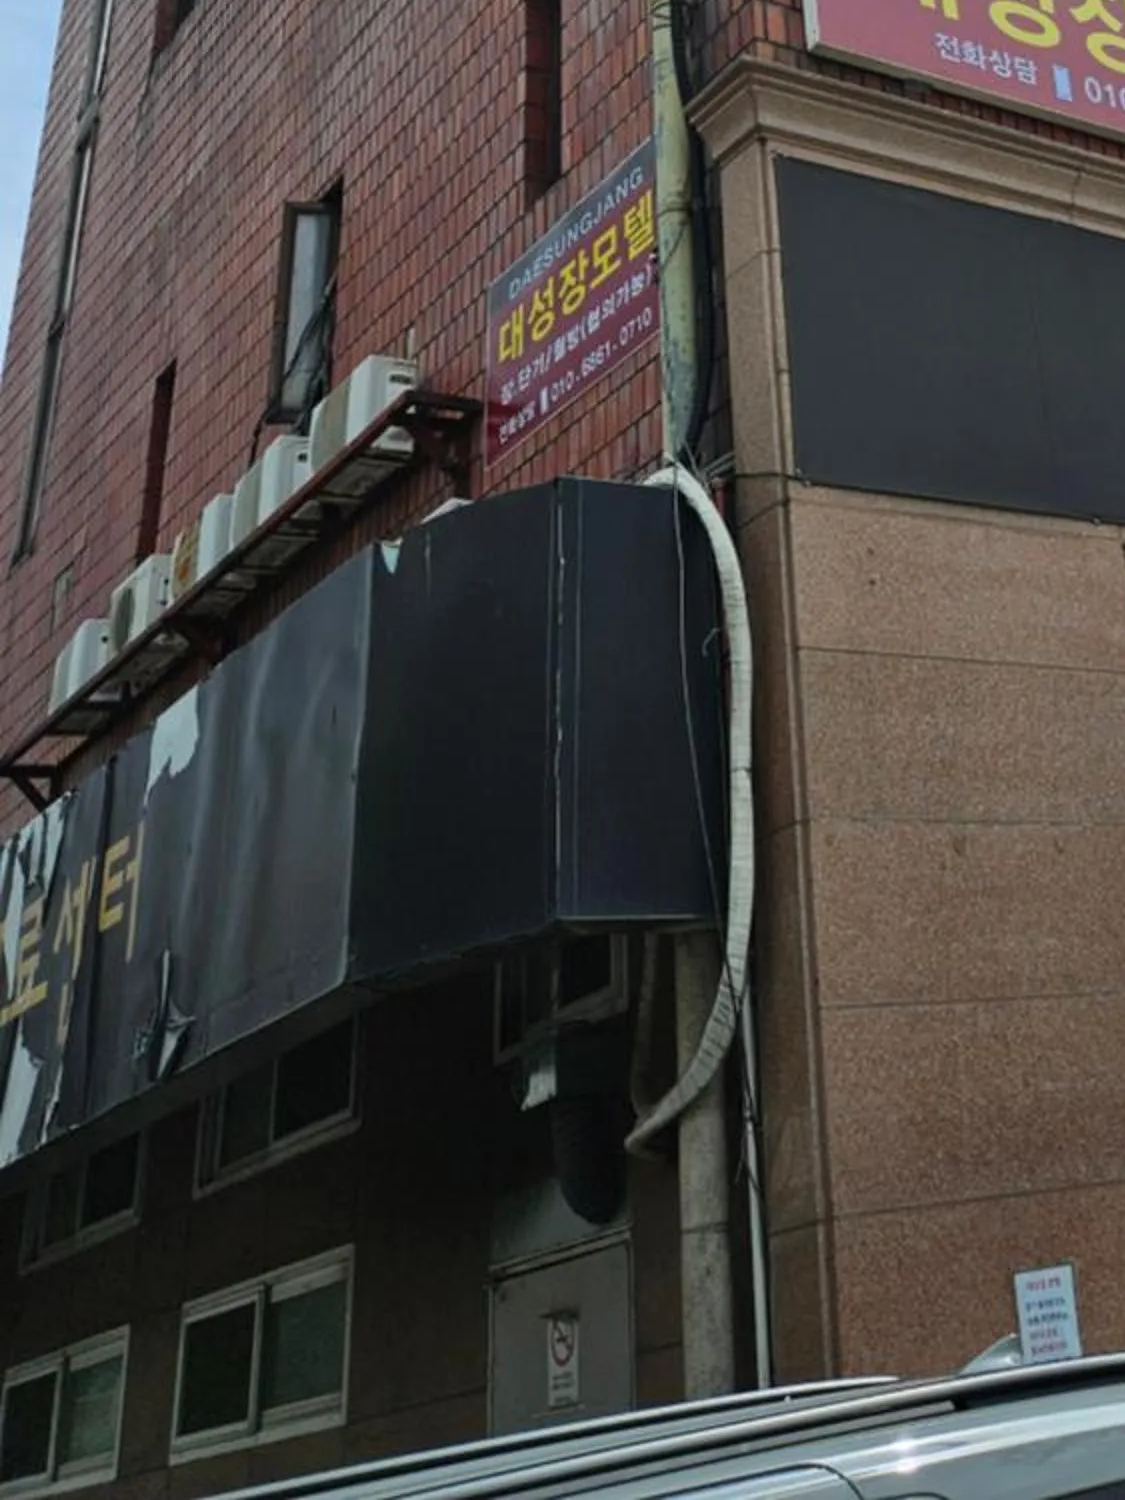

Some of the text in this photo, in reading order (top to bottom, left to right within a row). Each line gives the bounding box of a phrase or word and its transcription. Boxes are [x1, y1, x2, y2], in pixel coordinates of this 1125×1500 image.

[935, 32, 1038, 86] 전화상담
[497, 188, 656, 365] 대성장모텔
[508, 166, 644, 301] DAESUNGJANG
[0, 819, 146, 1027] 료센터
